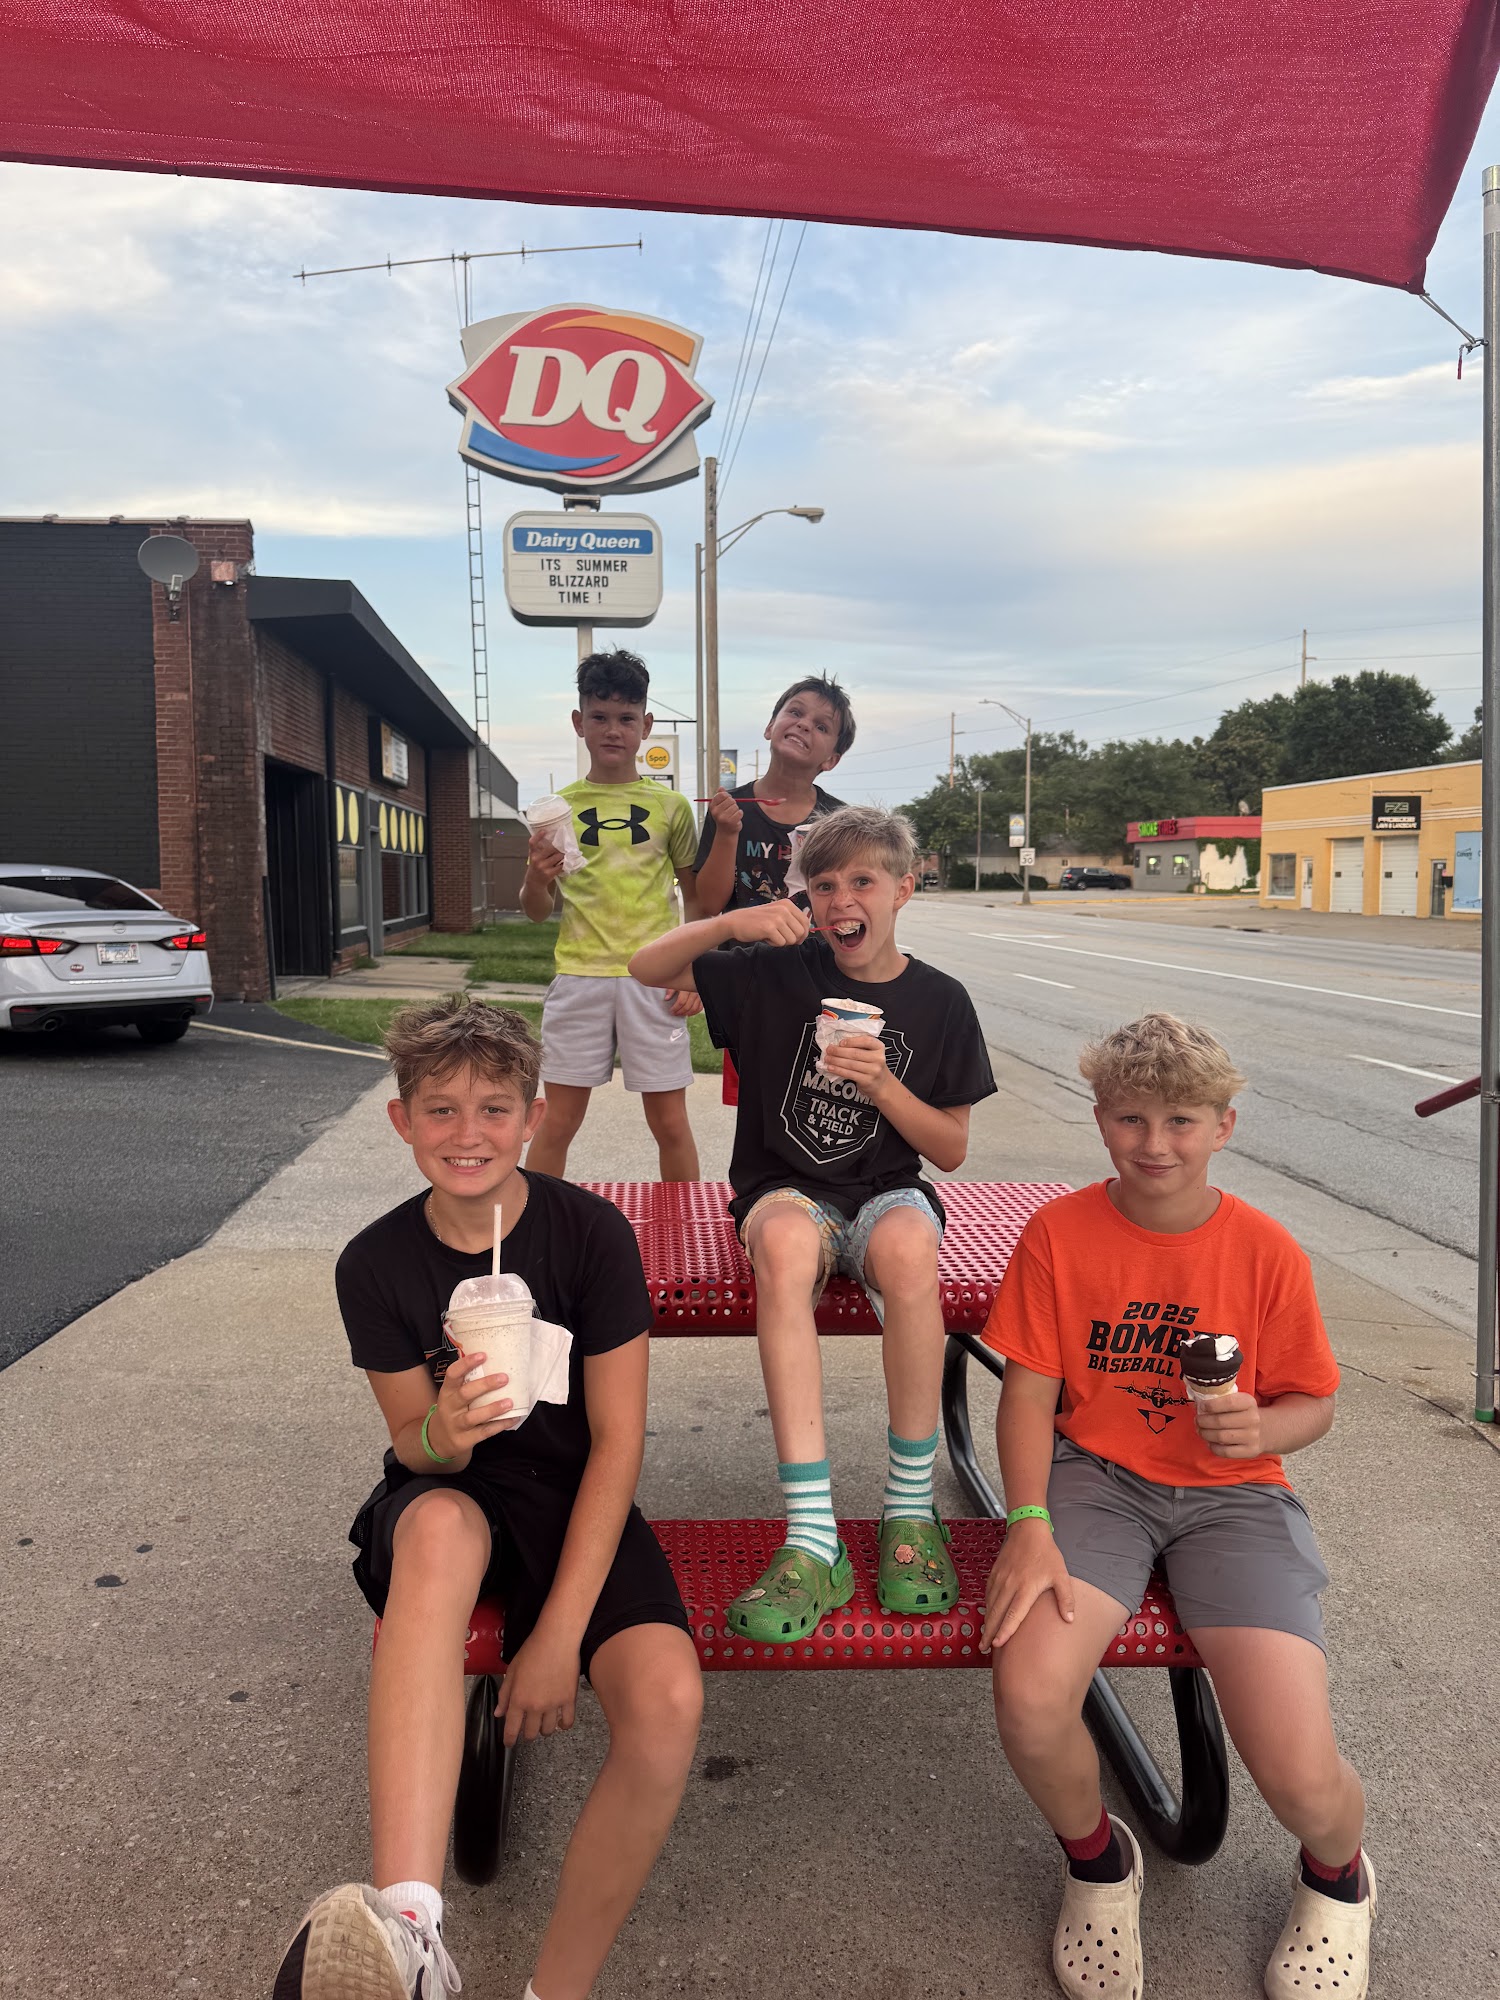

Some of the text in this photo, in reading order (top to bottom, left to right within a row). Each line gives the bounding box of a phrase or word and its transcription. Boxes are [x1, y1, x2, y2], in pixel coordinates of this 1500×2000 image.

[499, 345, 659, 446] DQ
[526, 531, 641, 551] Dairy Queen
[540, 559, 628, 573] ITS SUMMER
[549, 575, 609, 588] BLIZZARD
[558, 591, 590, 604] TIME
[649, 754, 668, 763] Spot
[746, 840, 774, 859] MY
[810, 1097, 863, 1126] TRACK
[807, 1113, 854, 1136] & FIELD
[1122, 1301, 1200, 1325] 2025
[1088, 1353, 1174, 1378] BASEBALL
